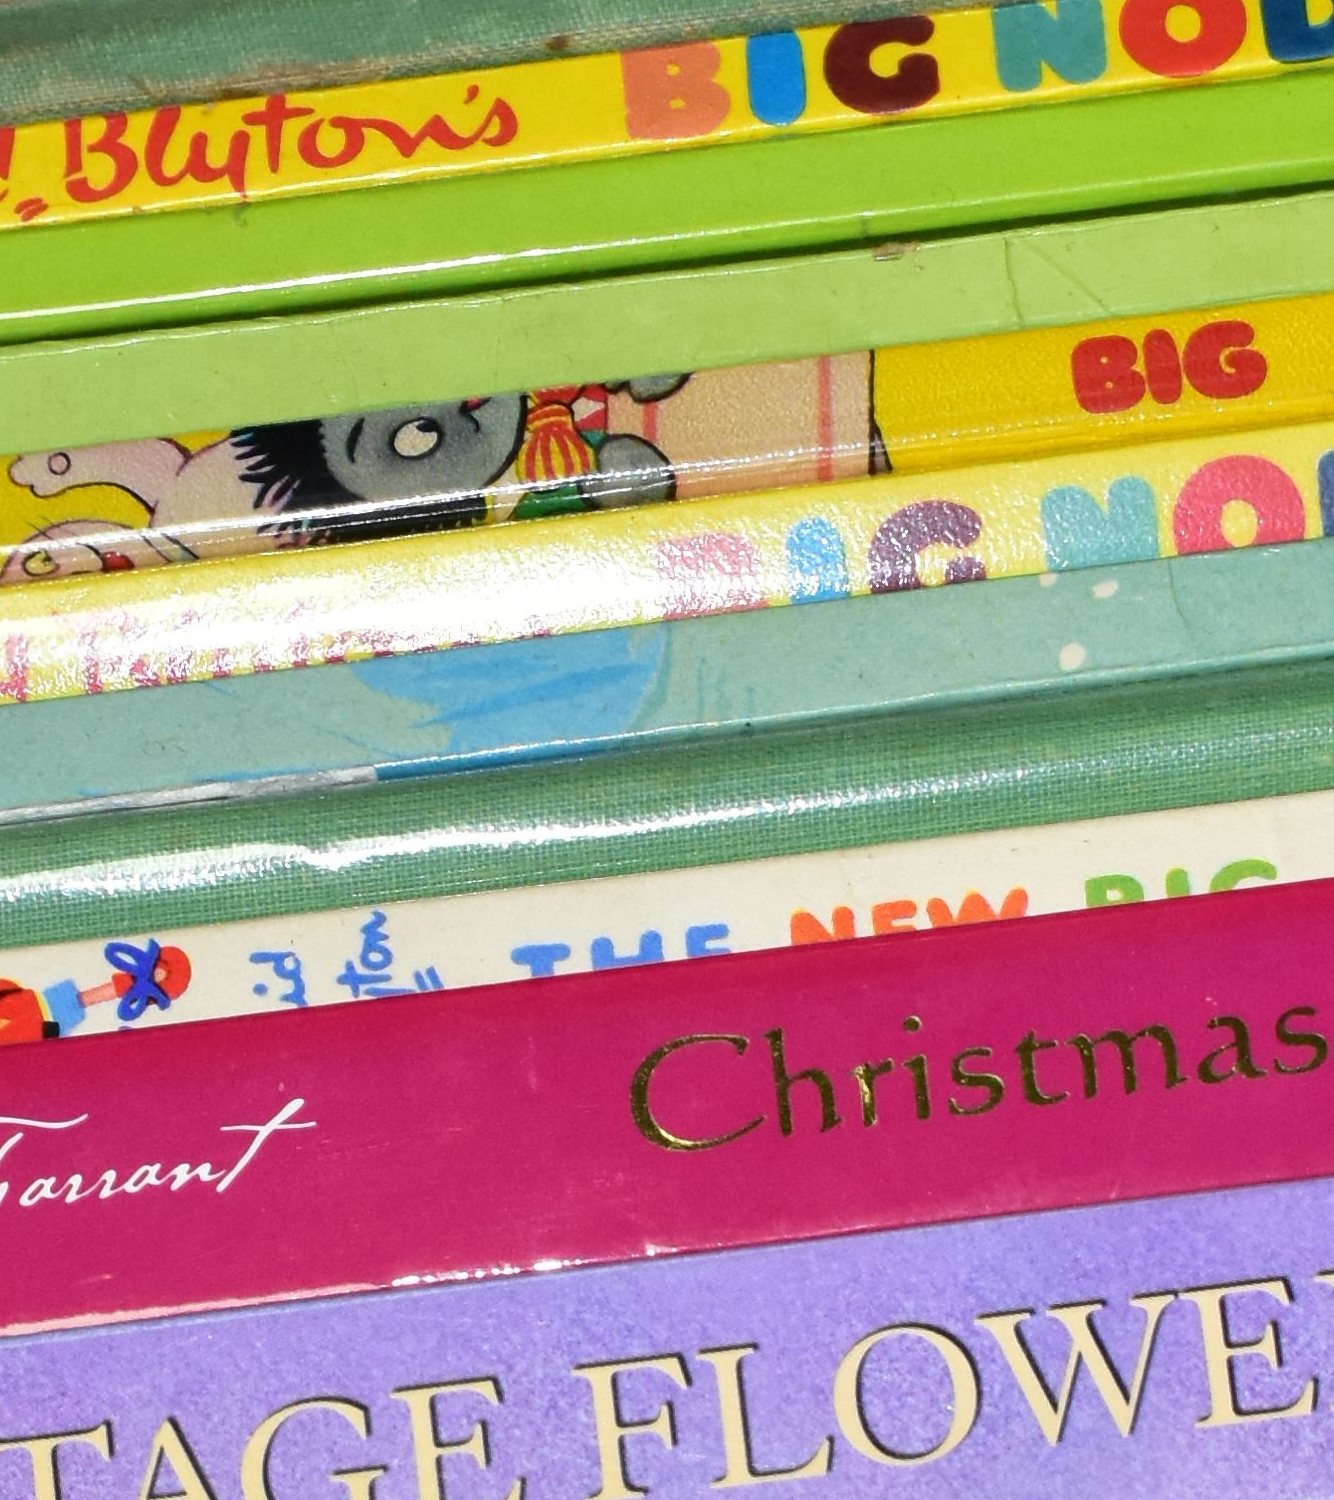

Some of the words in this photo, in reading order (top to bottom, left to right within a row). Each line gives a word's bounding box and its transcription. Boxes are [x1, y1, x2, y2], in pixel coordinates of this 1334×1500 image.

[65, 83, 522, 203] Blyton's
[617, 16, 939, 143] BIG
[1071, 320, 1267, 414] BIG
[654, 500, 989, 624] BIG
[631, 997, 1331, 1152] Christmas
